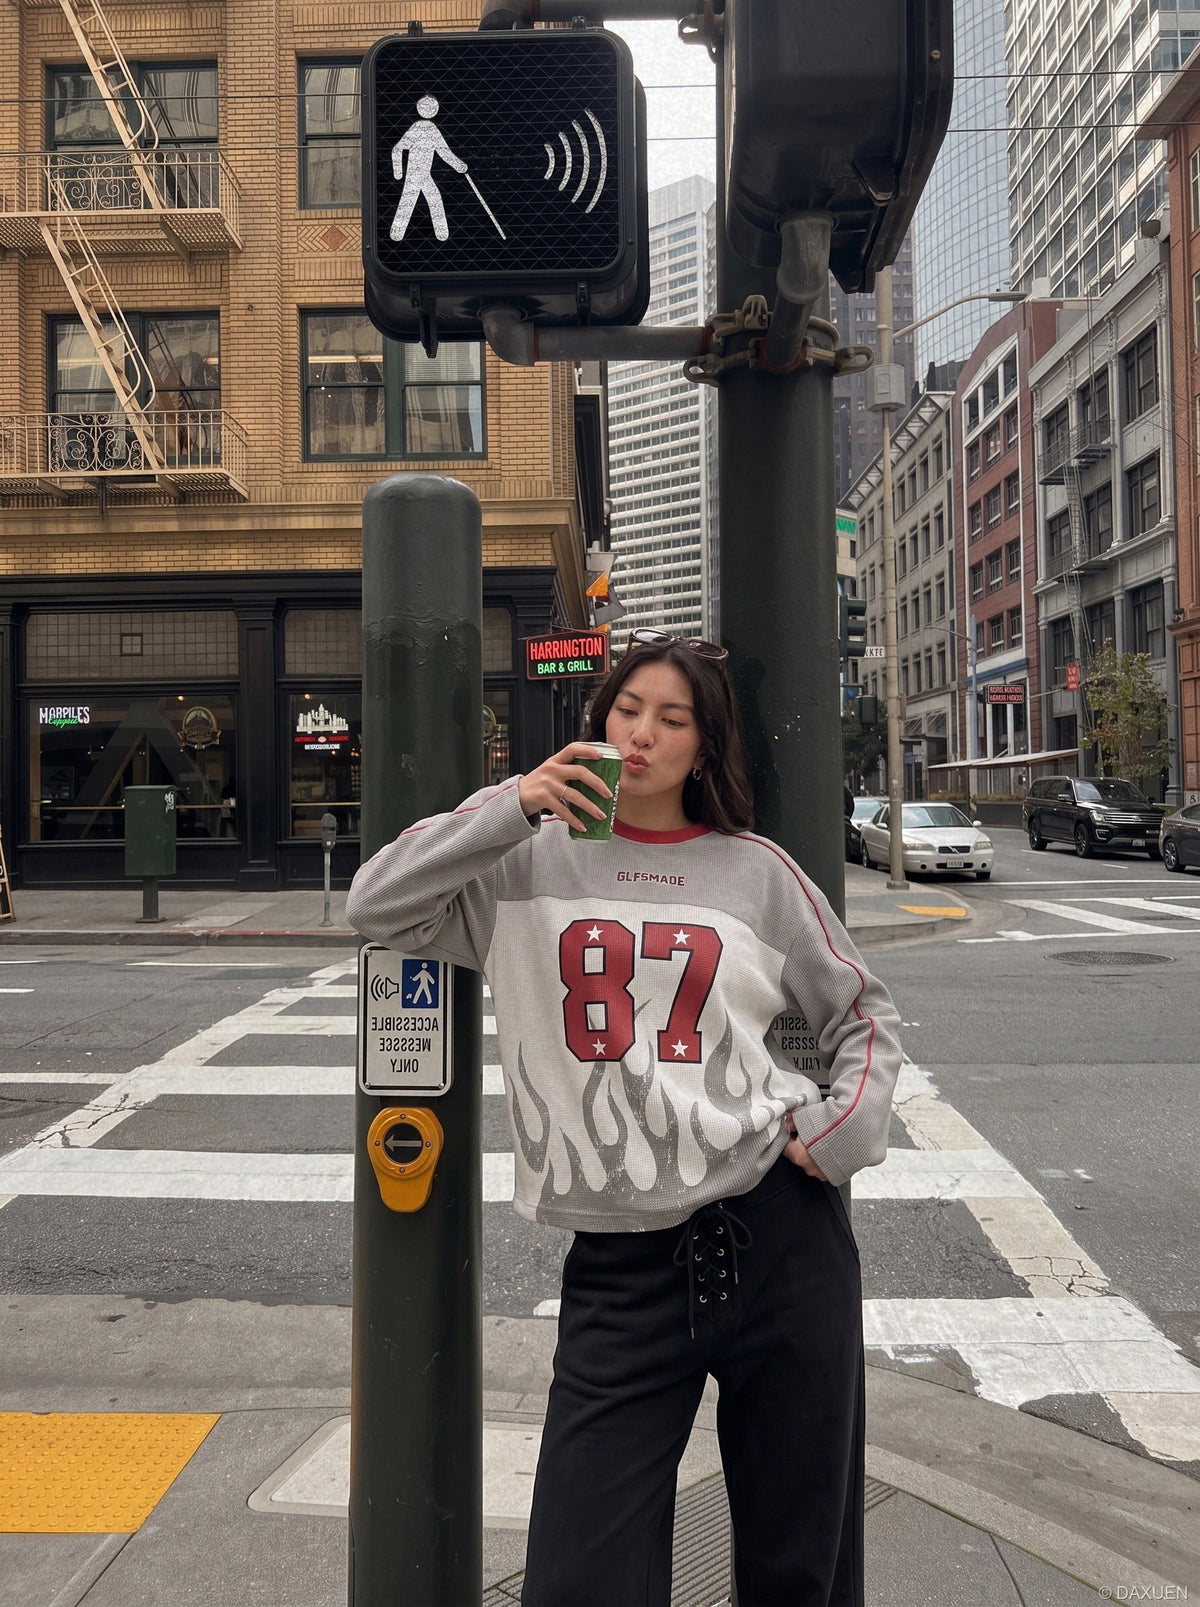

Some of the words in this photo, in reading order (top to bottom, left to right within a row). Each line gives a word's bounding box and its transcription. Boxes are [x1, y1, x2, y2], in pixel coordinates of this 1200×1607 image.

[530, 637, 602, 660] HARRINGTON
[537, 663, 556, 674] BAR
[558, 662, 565, 672] &
[567, 660, 593, 672] GRILL
[617, 871, 685, 886] GLFSMADE
[559, 918, 723, 1064] 87
